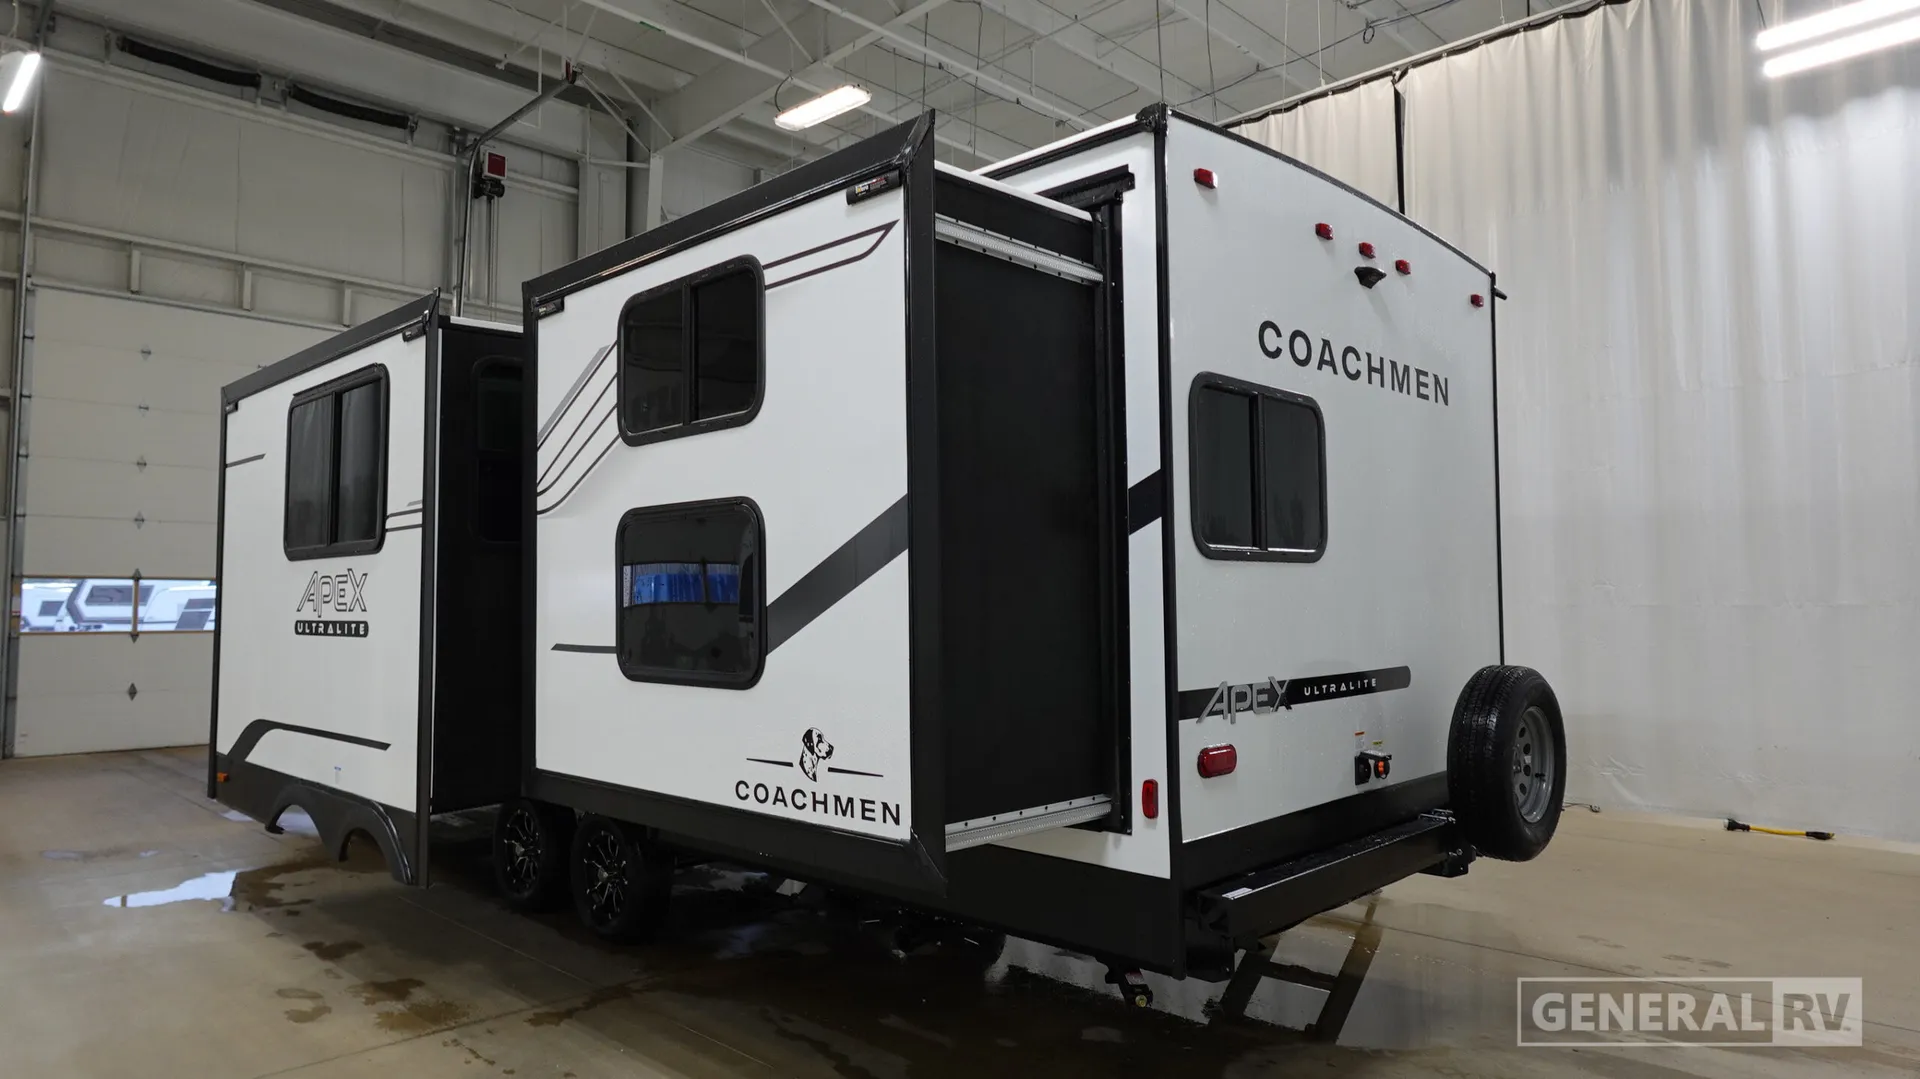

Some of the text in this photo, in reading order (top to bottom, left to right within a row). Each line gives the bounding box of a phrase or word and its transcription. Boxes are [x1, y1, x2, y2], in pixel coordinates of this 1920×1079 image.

[1258, 320, 1449, 406] COACHMEN
[296, 568, 368, 618] APEX
[297, 622, 365, 635] ULTRALITE
[1196, 676, 1377, 724] APEX ULTRALITE
[735, 780, 900, 826] COACHMEN
